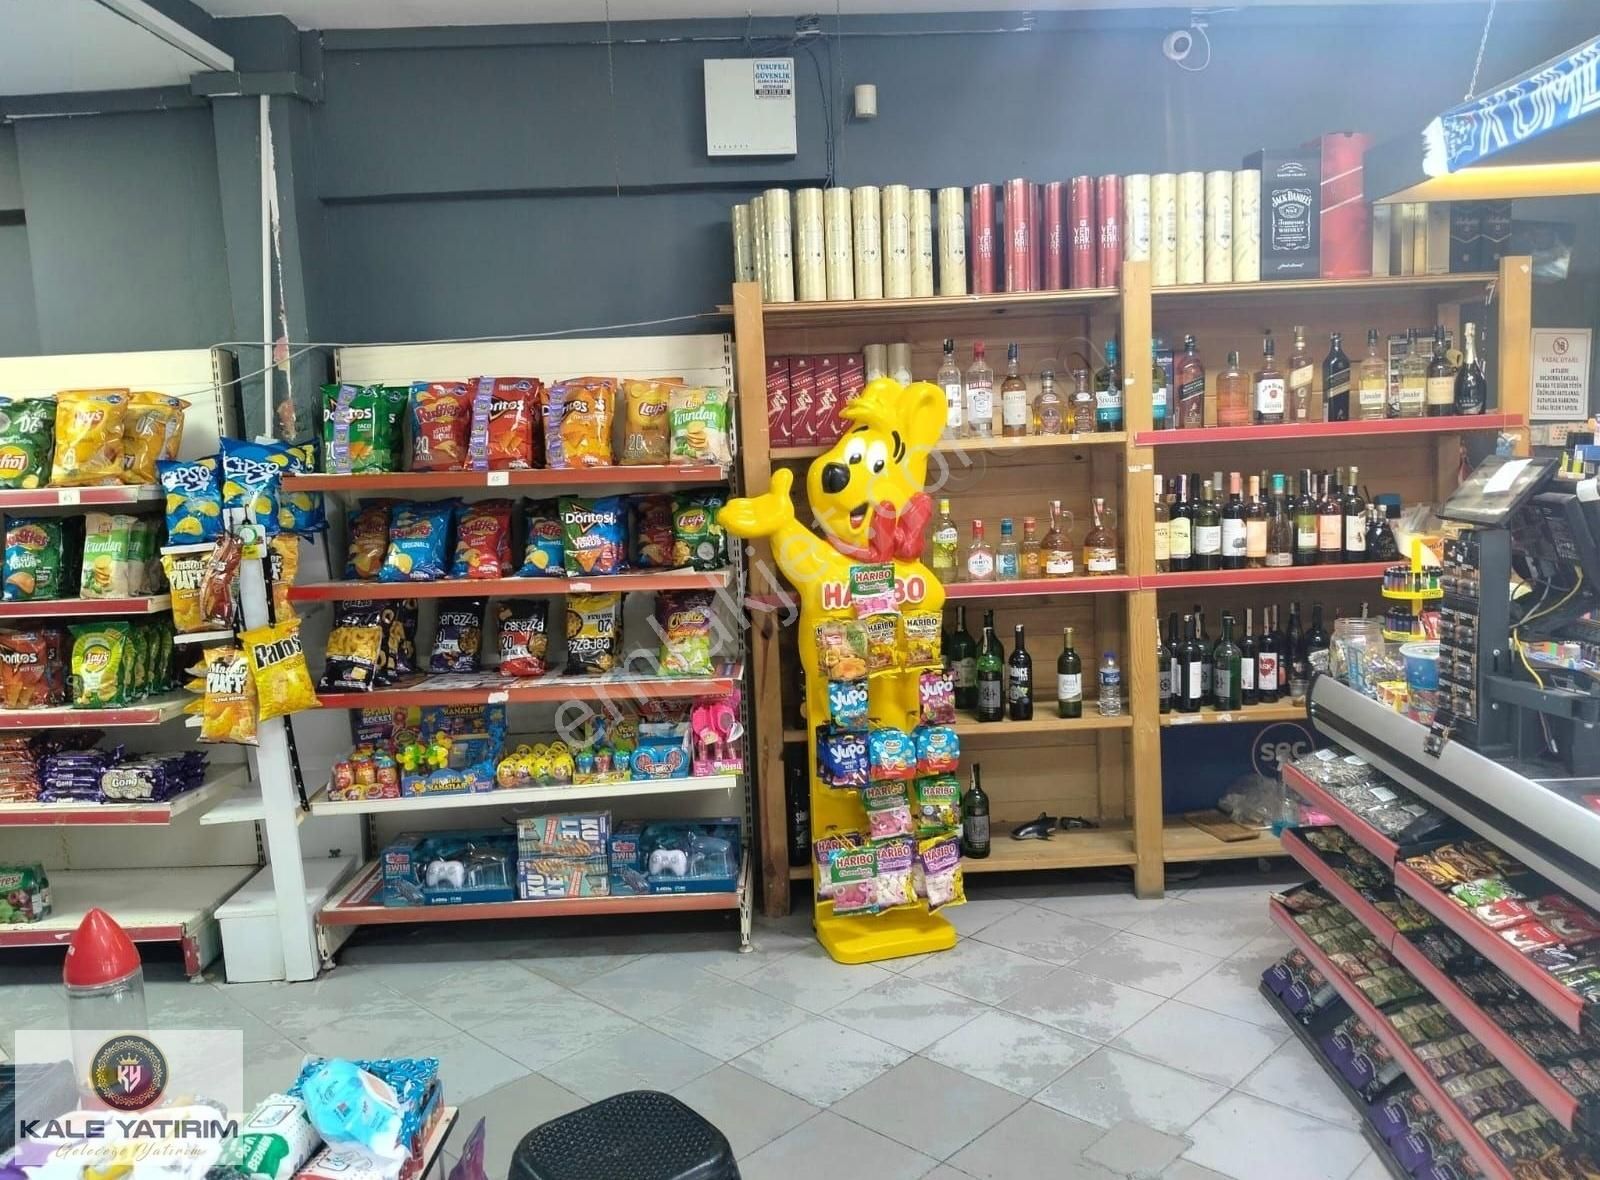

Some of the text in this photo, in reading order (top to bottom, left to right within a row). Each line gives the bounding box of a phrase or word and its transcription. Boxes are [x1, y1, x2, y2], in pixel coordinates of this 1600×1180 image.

[1271, 194, 1288, 207] JACK
[488, 400, 524, 412] oritos
[639, 401, 666, 417] Lay's
[323, 408, 372, 422] Dotos
[565, 512, 614, 525] Doritos
[678, 514, 706, 527] Lay's
[855, 570, 892, 583] HARIBO
[823, 577, 926, 609] HABO
[504, 618, 544, 632] cerezza
[868, 620, 894, 633] HARIBO
[906, 618, 937, 627] HARIBO
[0, 651, 37, 664] oritos
[84, 651, 110, 667] Lay's
[254, 634, 304, 671] Patos
[919, 679, 954, 701] Yupo
[830, 689, 868, 711] Yupo
[830, 744, 866, 762] Yupo
[923, 785, 956, 796] HARIBO
[923, 843, 956, 862] HARIBO
[835, 854, 874, 868] HARIBO
